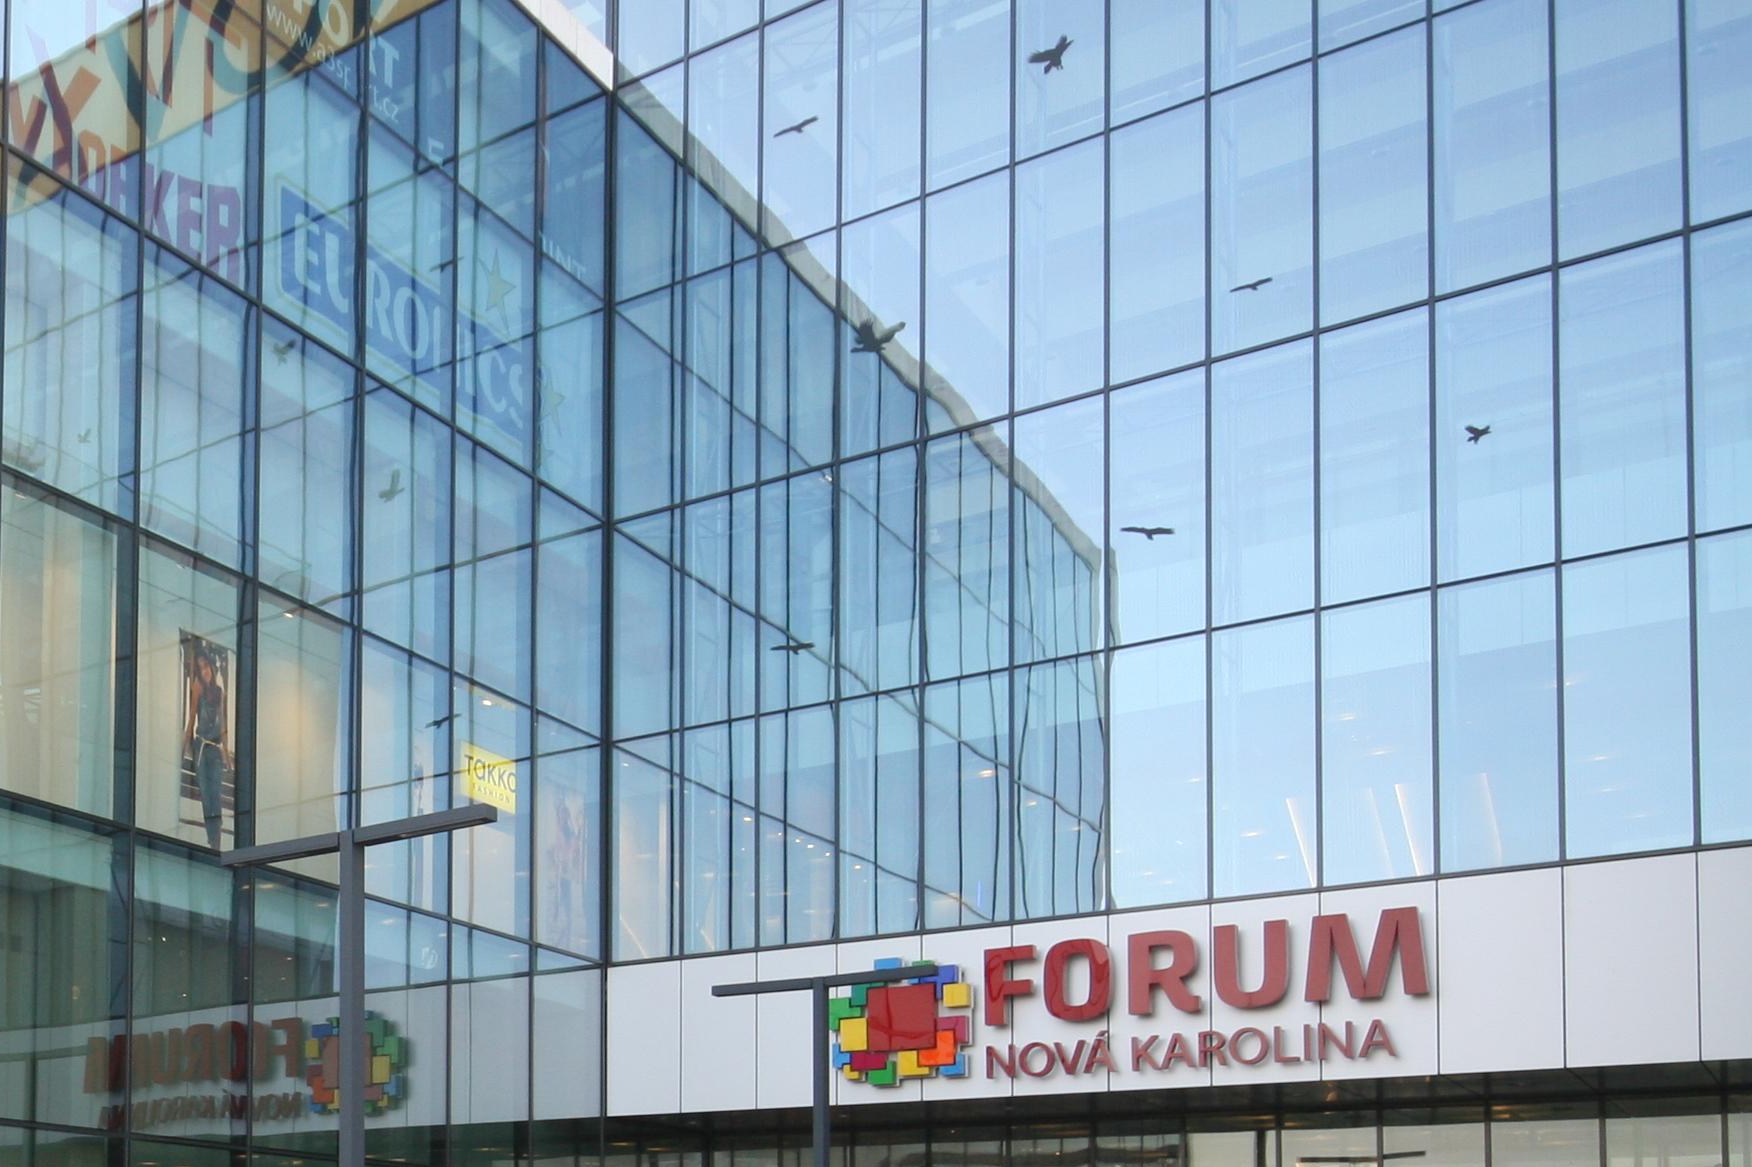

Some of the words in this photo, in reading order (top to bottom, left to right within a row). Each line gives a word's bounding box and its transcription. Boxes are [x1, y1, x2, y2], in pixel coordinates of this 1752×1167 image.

[983, 906, 1429, 1027] FORUM
[986, 1029, 1119, 1081] NOVÁ
[1131, 1018, 1399, 1073] KAROLINA
